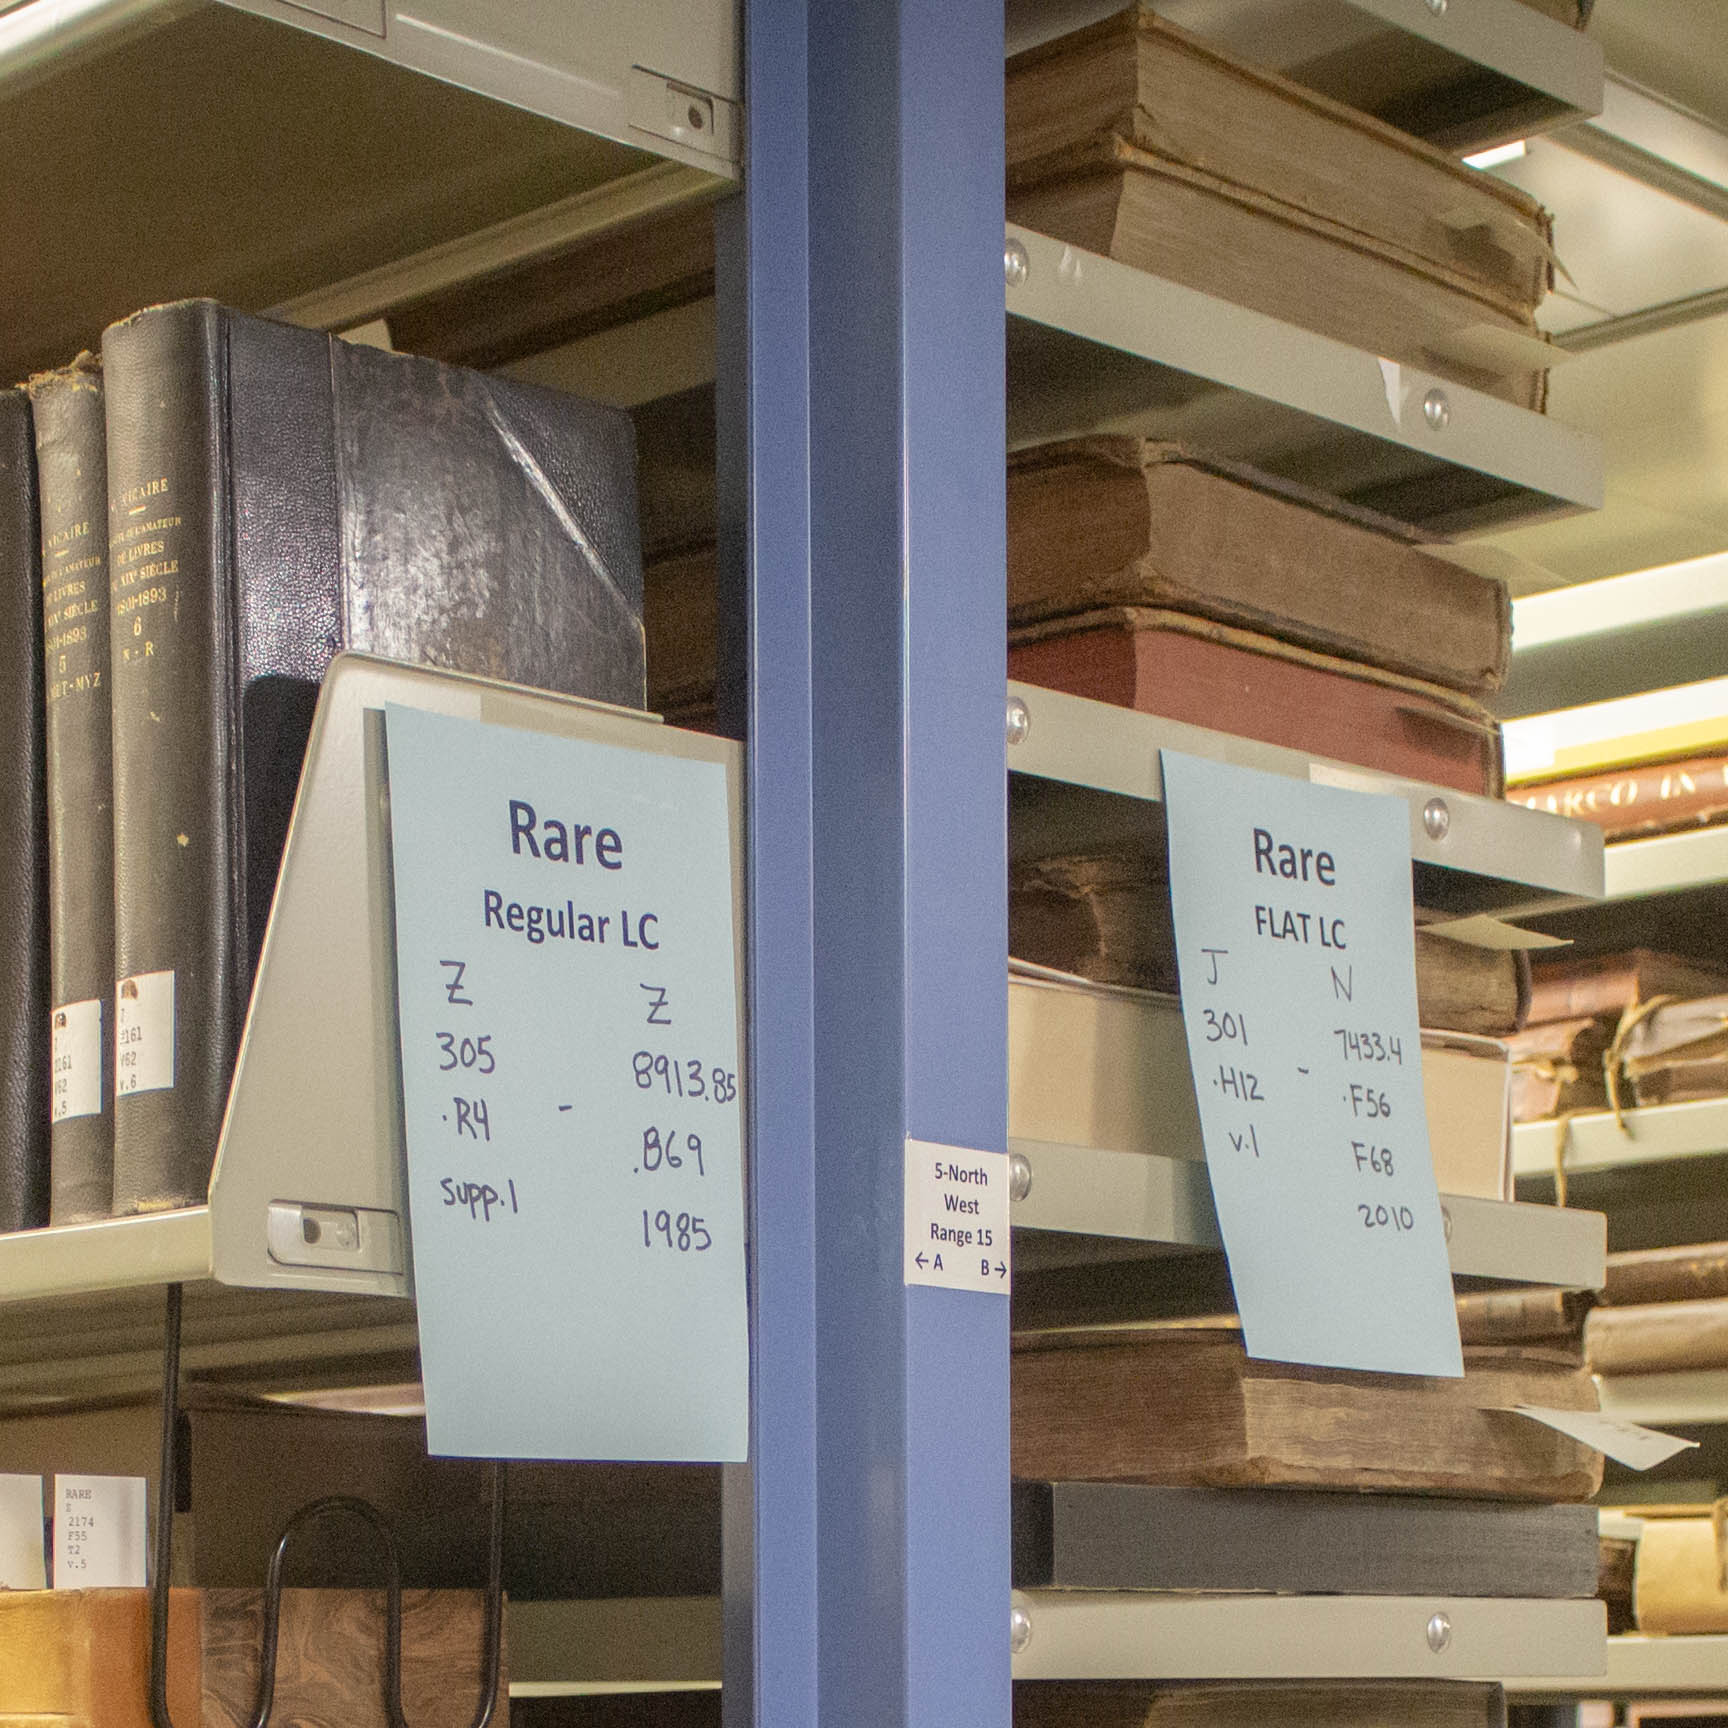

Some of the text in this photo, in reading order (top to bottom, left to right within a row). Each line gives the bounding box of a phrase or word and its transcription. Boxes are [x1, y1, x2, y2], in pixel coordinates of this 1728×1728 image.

[133, 616, 142, 636] 6
[58, 654, 67, 673] 5
[508, 799, 623, 870] Rare
[1253, 828, 1337, 886] Rare
[483, 889, 660, 950] Regular LC
[1254, 905, 1347, 950] FLAT LC
[439, 960, 474, 1006] Z
[1201, 949, 1228, 985] J
[1330, 965, 1353, 1002] N
[639, 983, 672, 1025] Z
[1203, 1009, 1248, 1046] 301
[436, 1031, 496, 1074] 305
[1333, 1029, 1402, 1065] 7433.4
[632, 1051, 737, 1103] 8913.85
[934, 1162, 989, 1186] 5-North
[1351, 1141, 1394, 1177] F68
[944, 1193, 980, 1215] West
[1358, 1204, 1414, 1231] 2010
[642, 1209, 712, 1252] 1985
[930, 1223, 993, 1248] Range 15
[933, 1254, 943, 1271] A
[981, 1259, 990, 1276] B
[65, 1488, 92, 1500] RARE
[67, 1531, 88, 1541] F55
[68, 1516, 95, 1528] 2174
[67, 1545, 81, 1555] T2
[67, 1559, 87, 1569] v.5
